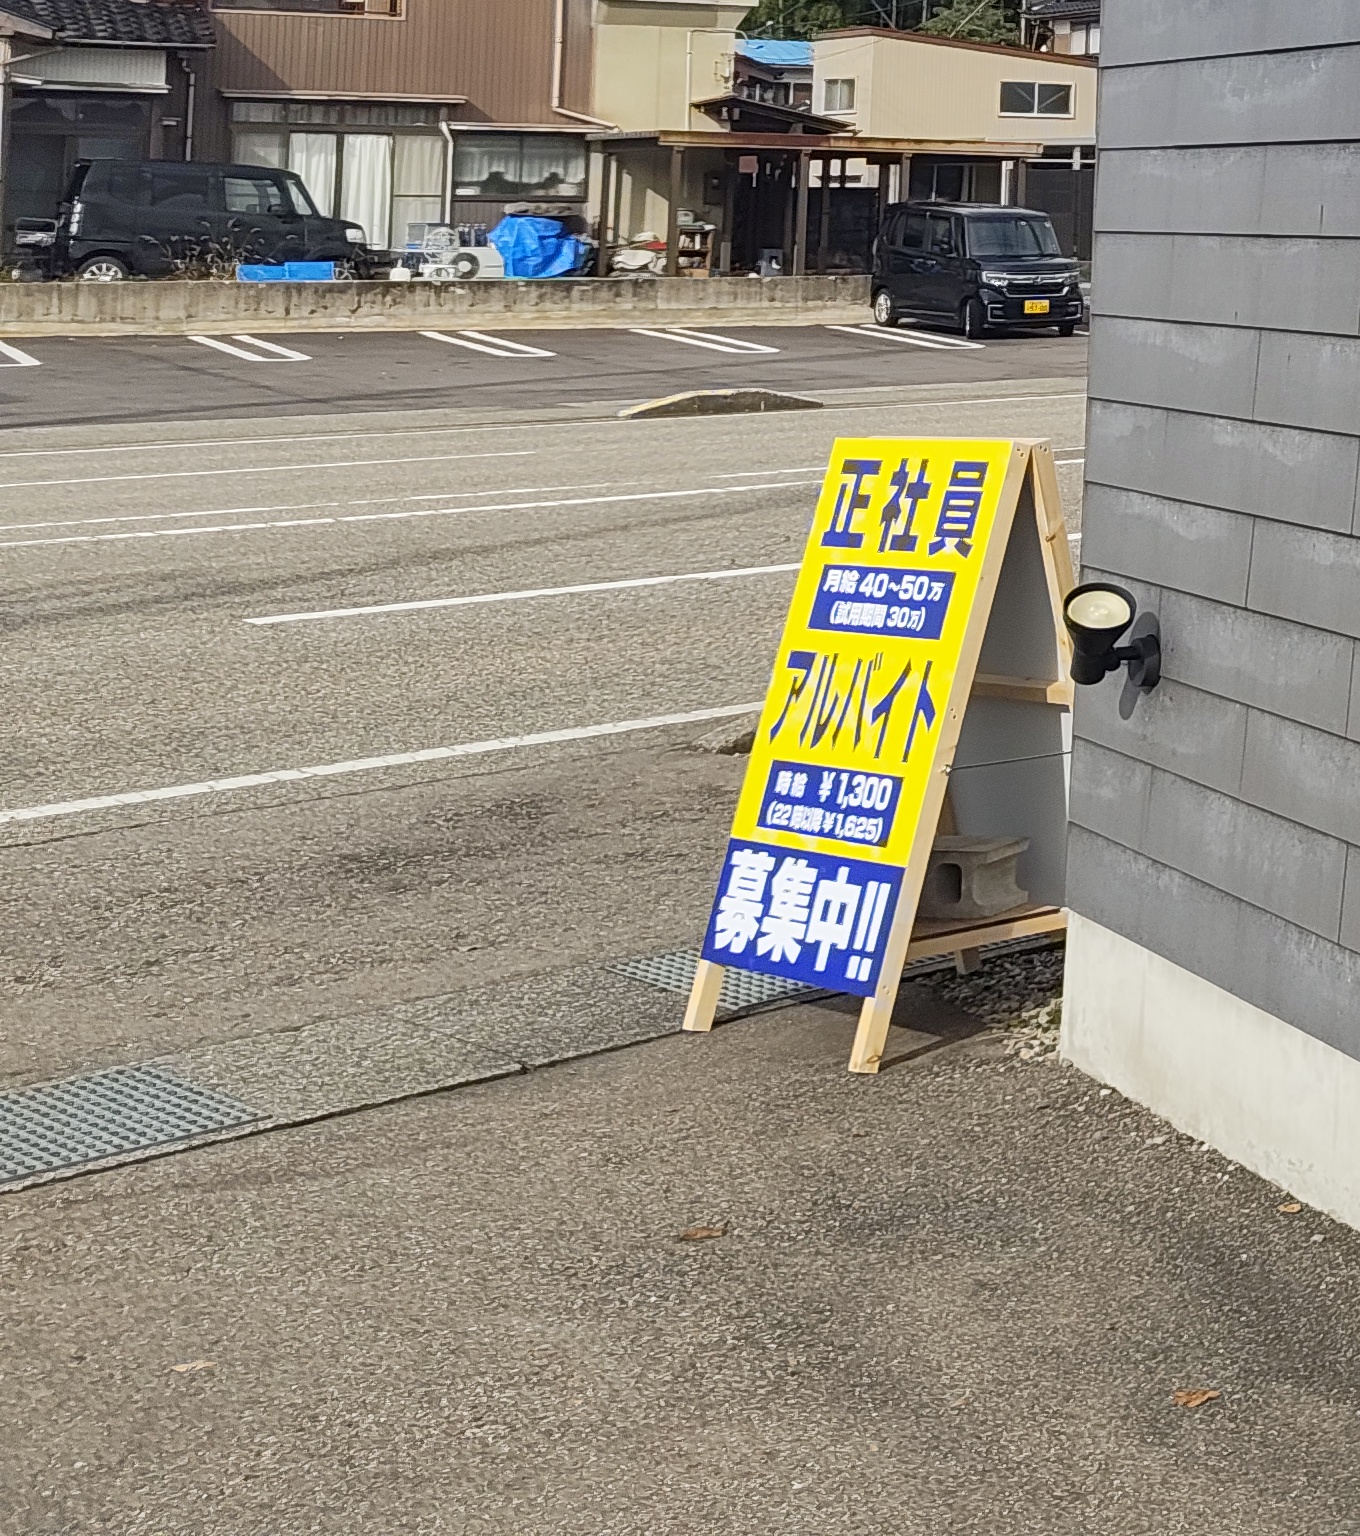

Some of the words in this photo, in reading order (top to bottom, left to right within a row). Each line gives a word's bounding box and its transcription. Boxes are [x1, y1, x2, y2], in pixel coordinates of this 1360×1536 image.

[820, 458, 990, 559] 正社員
[769, 650, 937, 763] アルバイト
[713, 848, 892, 982] 募集中!!
